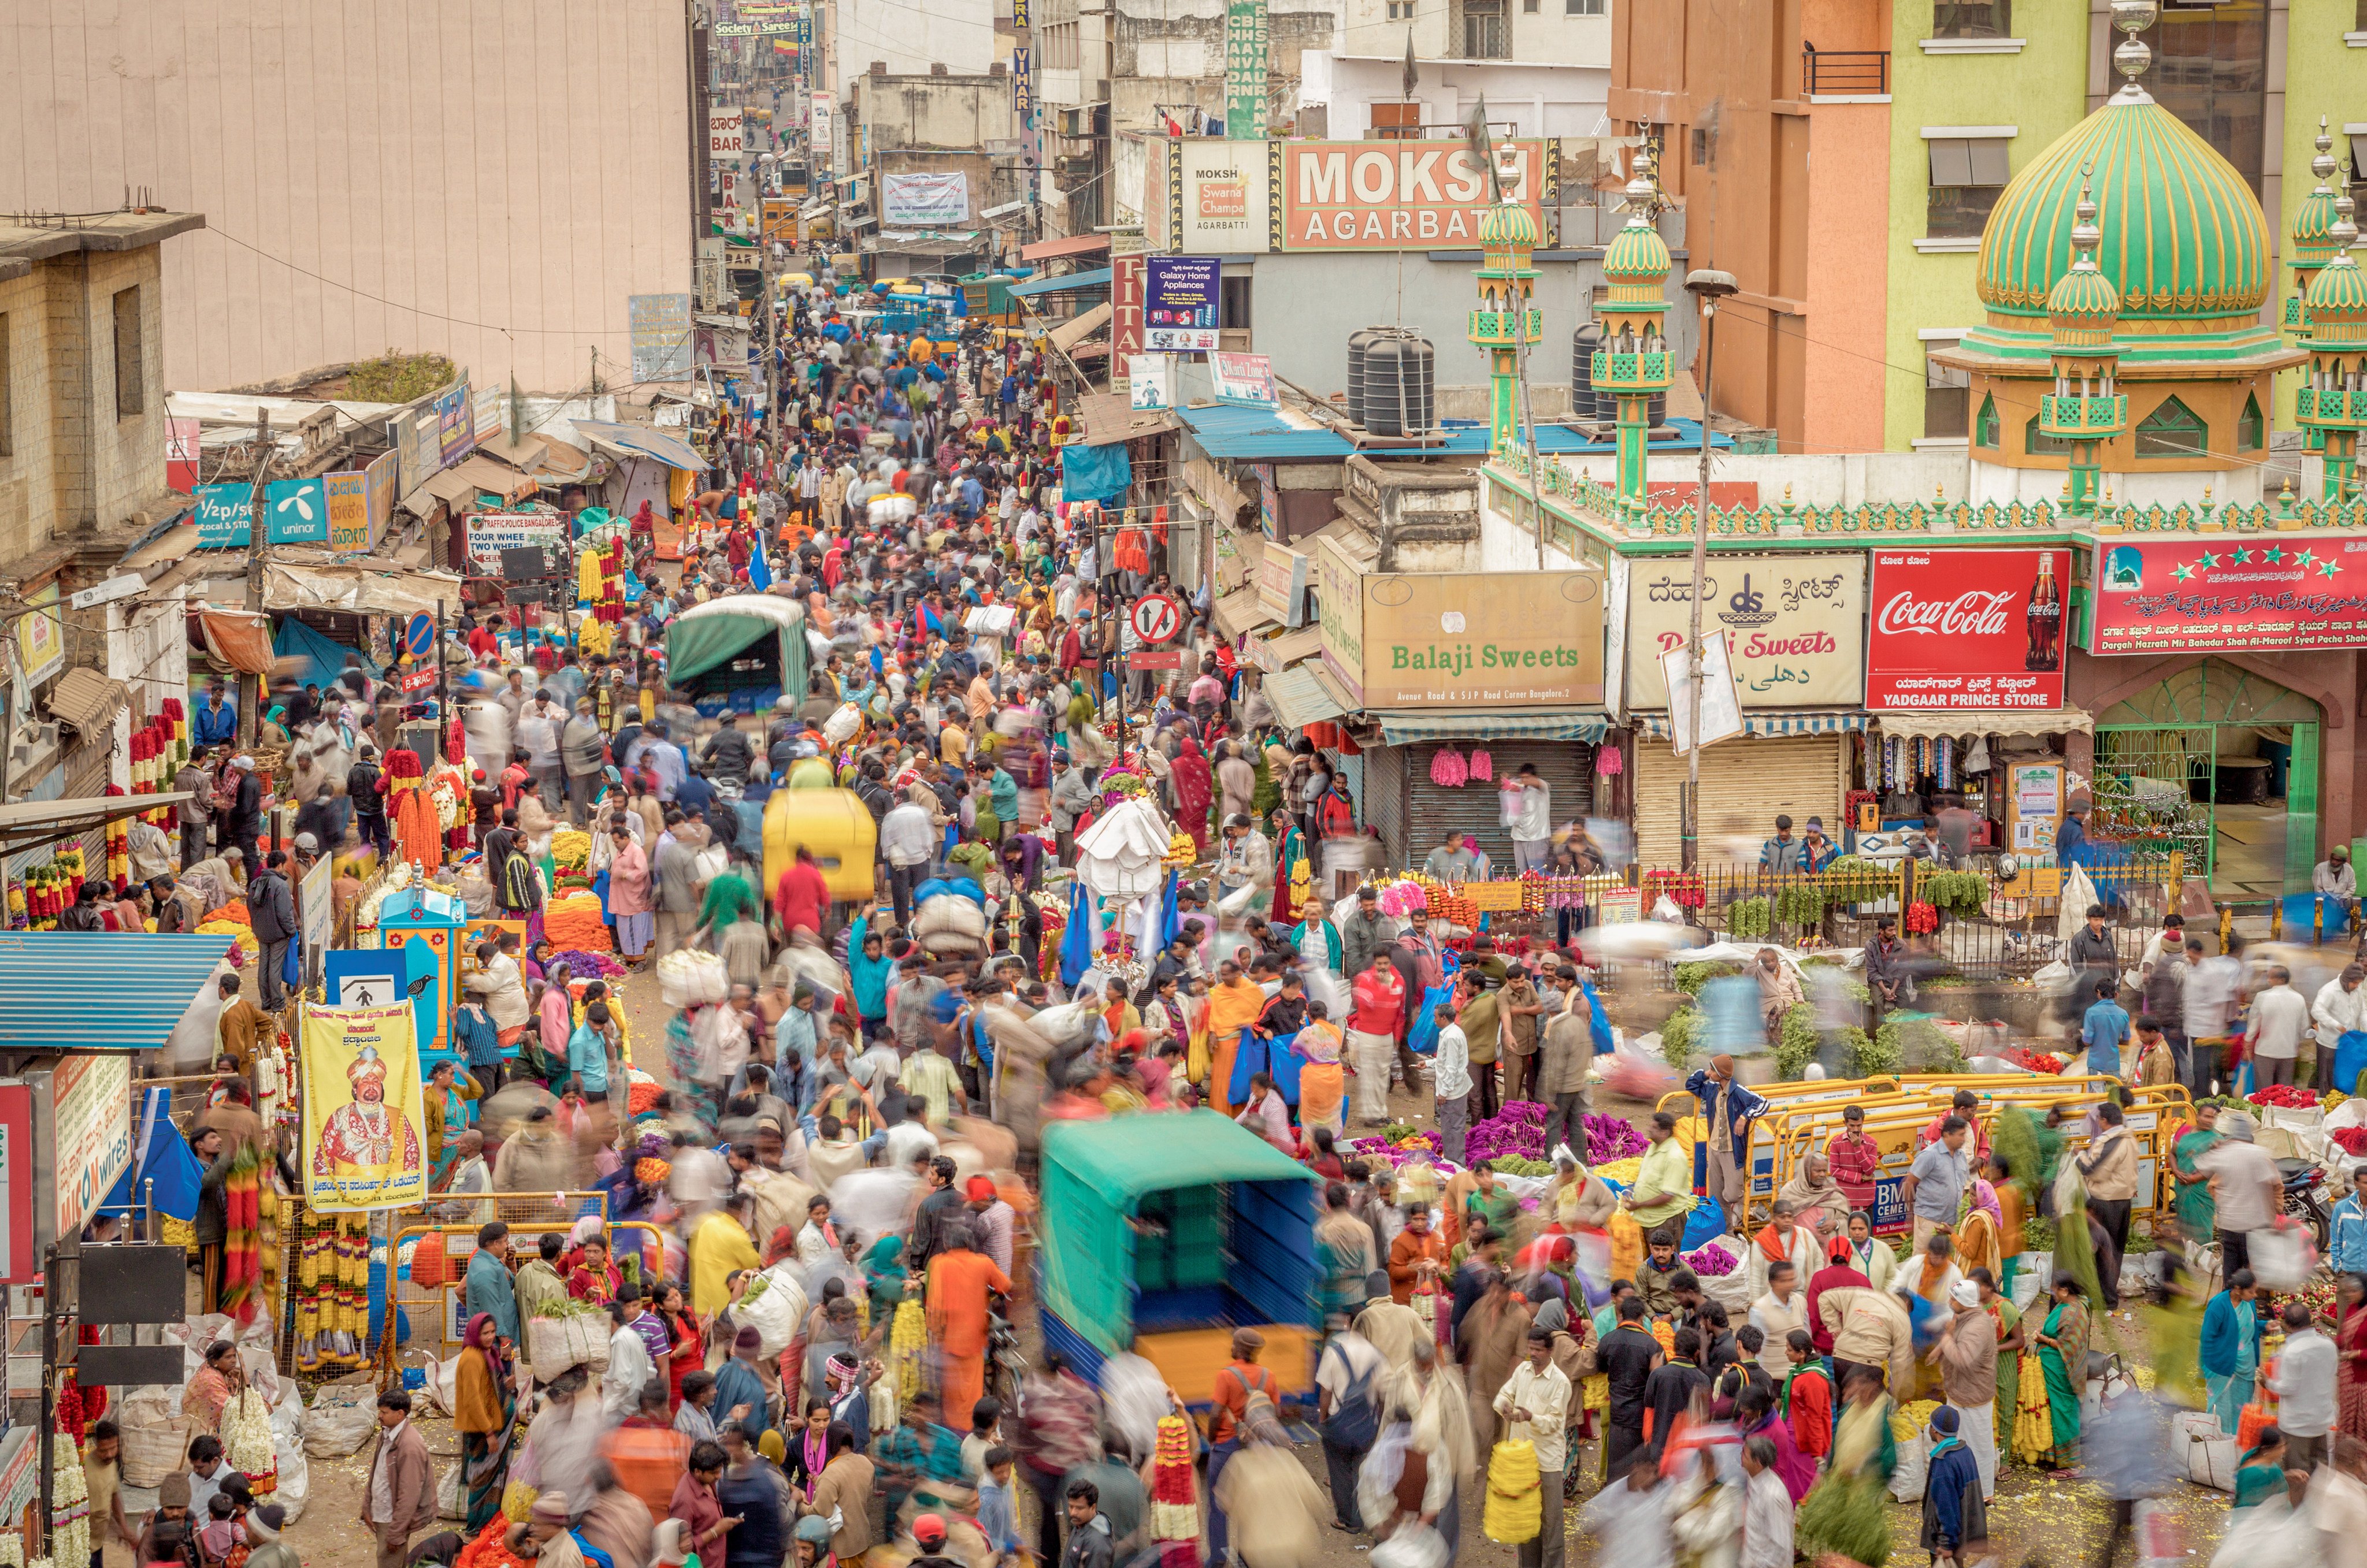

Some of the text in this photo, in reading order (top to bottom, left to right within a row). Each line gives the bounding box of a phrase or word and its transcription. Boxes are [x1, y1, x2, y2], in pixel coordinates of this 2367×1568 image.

[1015, 0, 1027, 27] RA
[715, 24, 752, 35] Society
[762, 22, 791, 32] Saree
[1228, 16, 1241, 110] CHANDRA
[1241, 16, 1254, 96] BHAVAN
[1253, 5, 1267, 138] RESTAURANT
[1015, 49, 1029, 110] VIHAR
[711, 114, 742, 131] ಬಾರ್
[711, 136, 743, 151] BAR
[1196, 169, 1238, 179] MOKSH
[1203, 184, 1242, 198] Swarna
[724, 175, 735, 227] BAR
[1201, 200, 1244, 215] Champa
[1197, 221, 1248, 229] AGARBATTI
[1304, 209, 1489, 240] AGARBAT
[726, 254, 752, 264] BAR
[1160, 272, 1186, 281] Galaxy
[1163, 281, 1205, 289] Appliances
[1116, 258, 1141, 373] TITAN
[1245, 362, 1264, 378] Zone
[329, 480, 365, 497] ವಿಜಯ
[201, 522, 223, 531] Local
[233, 521, 250, 529] STD
[283, 523, 316, 534] uninor
[484, 518, 555, 528] TRAFFIC POLICE BANGALORE
[497, 533, 525, 541] WHEE
[1880, 556, 1930, 565] ಕೋಕ ಕೋಲ
[1878, 590, 2017, 635] Coca-Cola
[2027, 602, 2060, 616] Coca-Cola
[34, 614, 44, 629] KPL
[1743, 630, 1837, 659] Sweets
[2101, 641, 2132, 651] Dargah
[2135, 639, 2169, 649] Hazrath
[2171, 639, 2186, 648] Mir
[2188, 638, 2225, 648] Bahadur
[2227, 637, 2247, 646] Shah
[2250, 636, 2292, 646] Al-Maroof
[2295, 636, 2315, 646] Syed
[2317, 635, 2343, 644] Pacha
[1392, 644, 1579, 677] Balaji Sweets
[1397, 692, 1422, 700] Avenue
[1427, 691, 1445, 700] Road
[1450, 691, 1455, 700] &
[1483, 690, 1501, 699] Road
[1504, 690, 1527, 699] Corner
[1883, 693, 2048, 705] YADGAAR PRINCE STORE
[61, 1155, 99, 1236] MICON
[99, 1129, 128, 1187] wires
